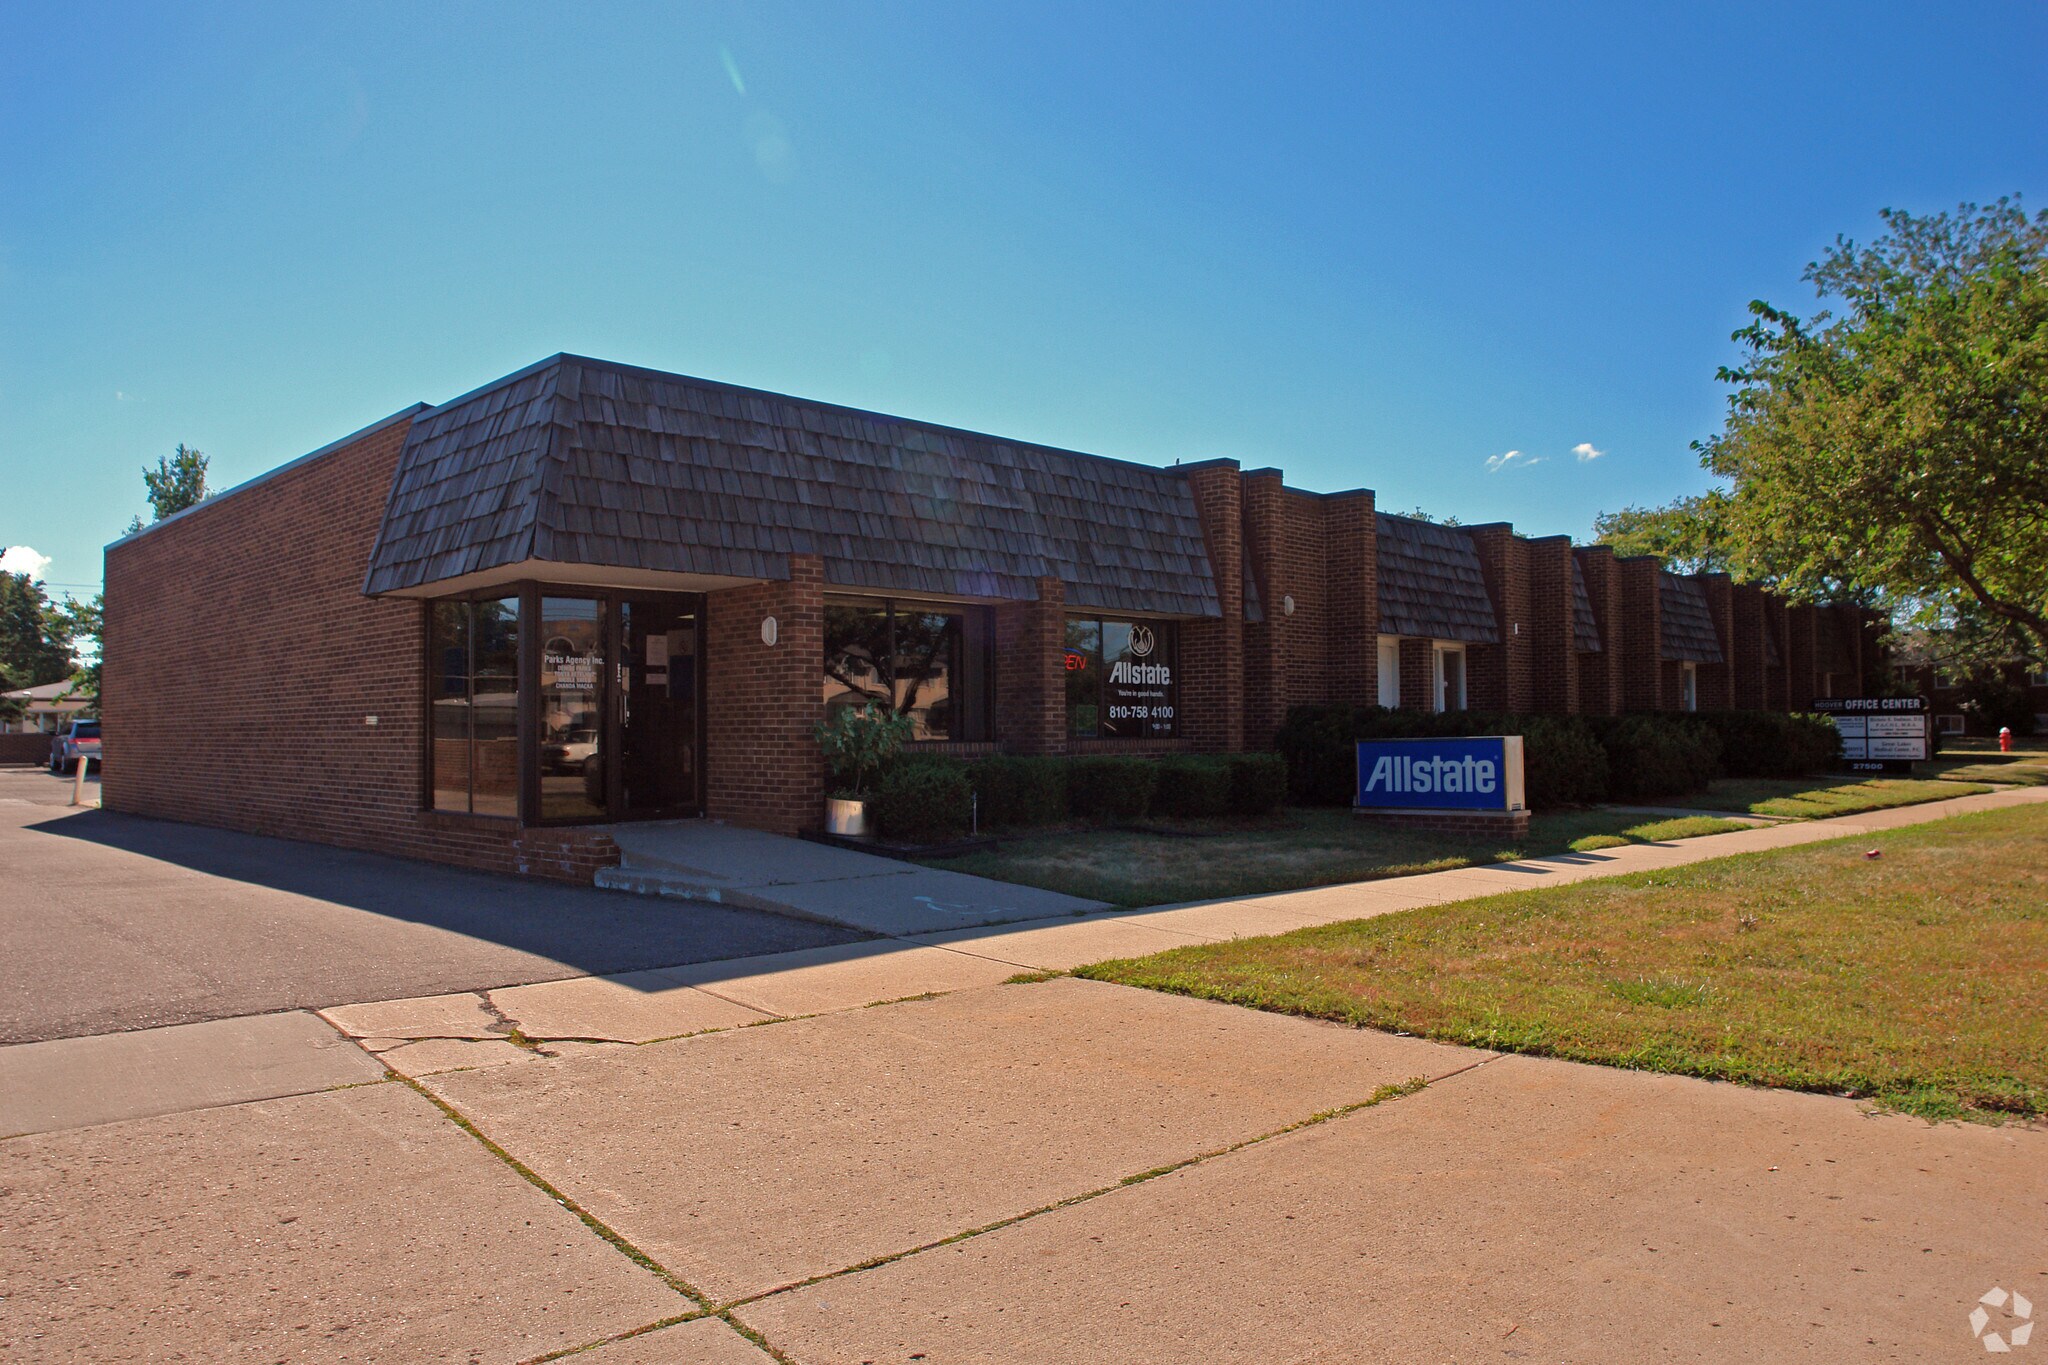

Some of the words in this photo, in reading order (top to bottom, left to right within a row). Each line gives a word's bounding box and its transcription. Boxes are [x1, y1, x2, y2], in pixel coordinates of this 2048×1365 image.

[544, 655, 564, 664] Parks
[565, 655, 591, 666] Agency
[592, 656, 605, 665] Inc.
[1109, 661, 1171, 685] Allstate
[1117, 689, 1132, 697] You're
[1132, 689, 1137, 697] in
[1138, 689, 1149, 698] good
[1845, 699, 1879, 710] OFFICE
[1881, 698, 1921, 709] CENTER
[1109, 706, 1148, 719] 810-758
[1151, 705, 1174, 719] 4100
[1364, 755, 1496, 794] Allstate
